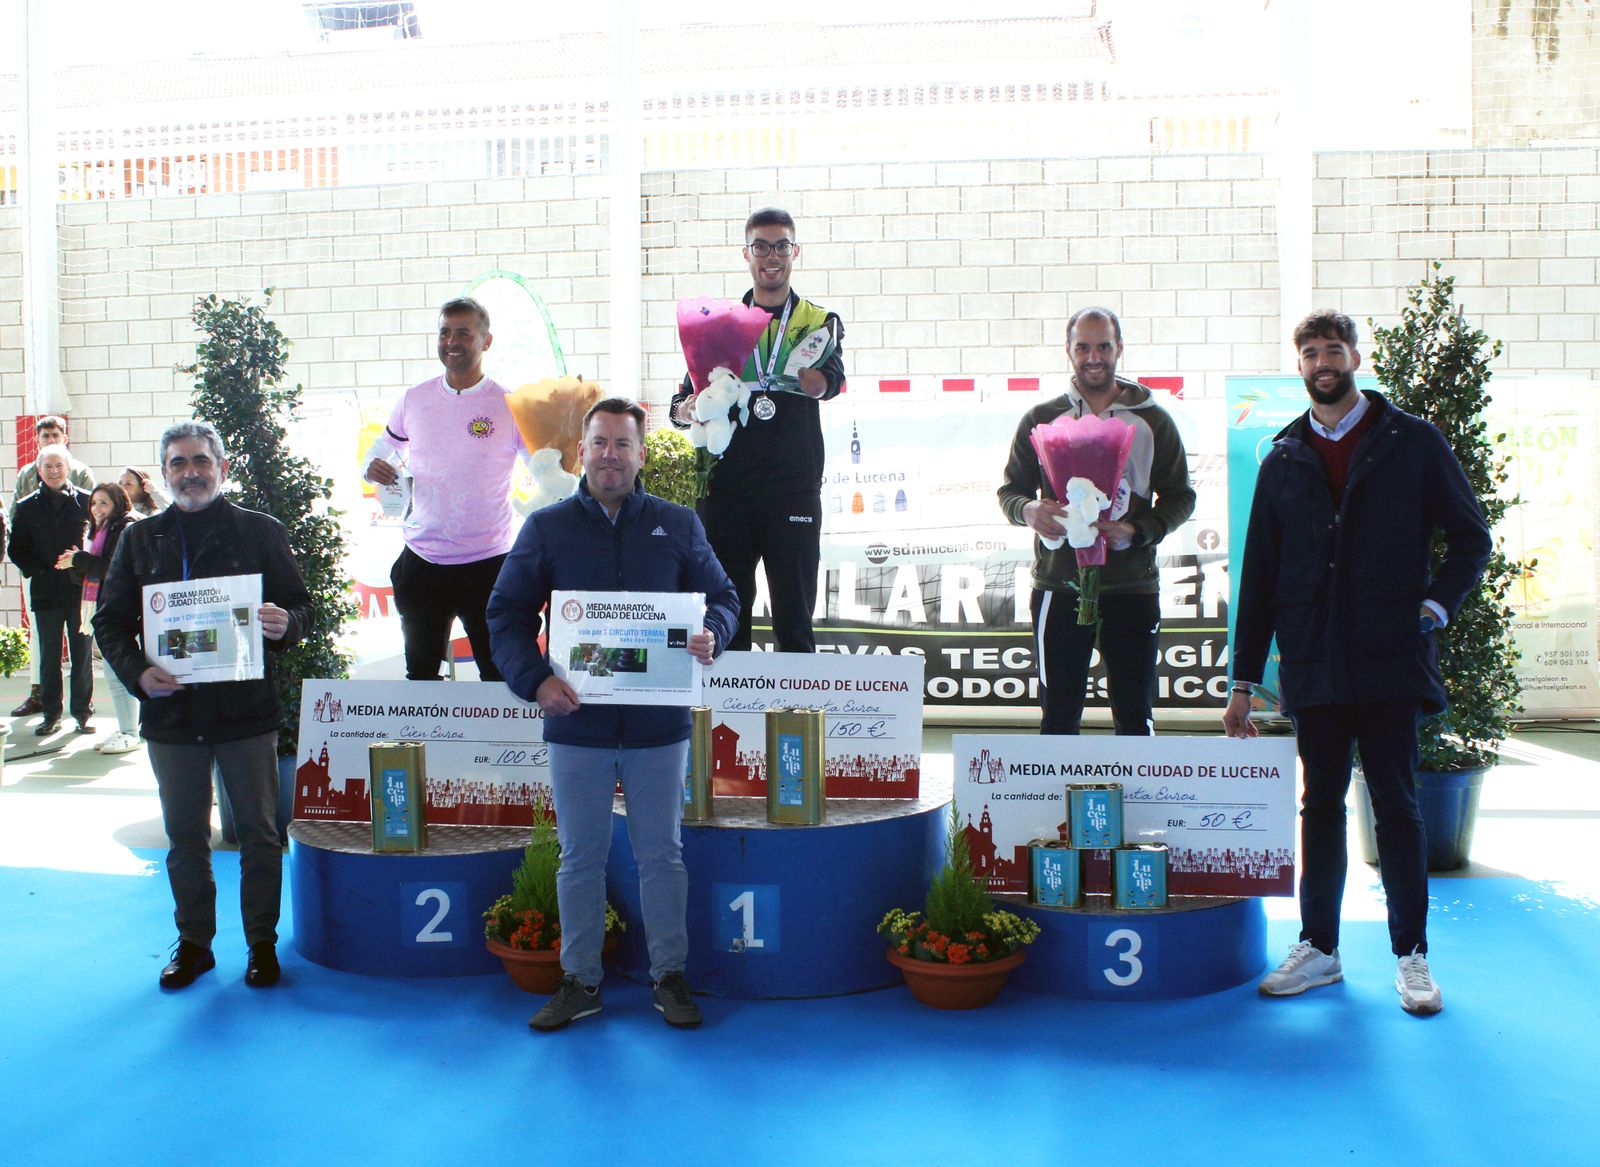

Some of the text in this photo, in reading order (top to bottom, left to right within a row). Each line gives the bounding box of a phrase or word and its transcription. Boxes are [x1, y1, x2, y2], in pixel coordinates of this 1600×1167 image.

[833, 472, 850, 484] de
[856, 471, 906, 484] Lucena
[168, 588, 221, 600] MEDIA MARATÓN
[168, 598, 193, 608] CIUDAD
[203, 595, 231, 604] LUCENA
[586, 602, 655, 612] MEDIA MARATÓN
[586, 611, 666, 621] CIUDAD DE LUCENA
[1541, 621, 1588, 629] Internacional
[609, 628, 639, 636] CIRCUITO
[640, 629, 667, 637] TERMAL
[709, 675, 776, 690] MARATÓN
[780, 678, 830, 691] CIUDAD
[834, 679, 852, 691] DE
[856, 680, 909, 692] LUCENA
[346, 703, 545, 720] MEDIA MARATÓN CIUDAD DE LUC
[722, 697, 766, 710] Ciento
[843, 699, 881, 713] Euros
[330, 730, 389, 739] La cantidad de:
[400, 725, 465, 739] Cien Euros
[829, 720, 886, 738] 150 €
[474, 755, 491, 764] EUR:
[497, 748, 549, 766] 100 €
[1009, 761, 1281, 779] MEDIA MARATÓN CIUDAD DE LUCENA
[991, 792, 1063, 801] La cantidad de:
[1156, 786, 1198, 801] Euros
[1167, 819, 1187, 828] EUR:
[1200, 811, 1253, 829] 50 €
[415, 888, 453, 943] 2
[729, 891, 764, 949] 1
[1103, 928, 1143, 987] 3
